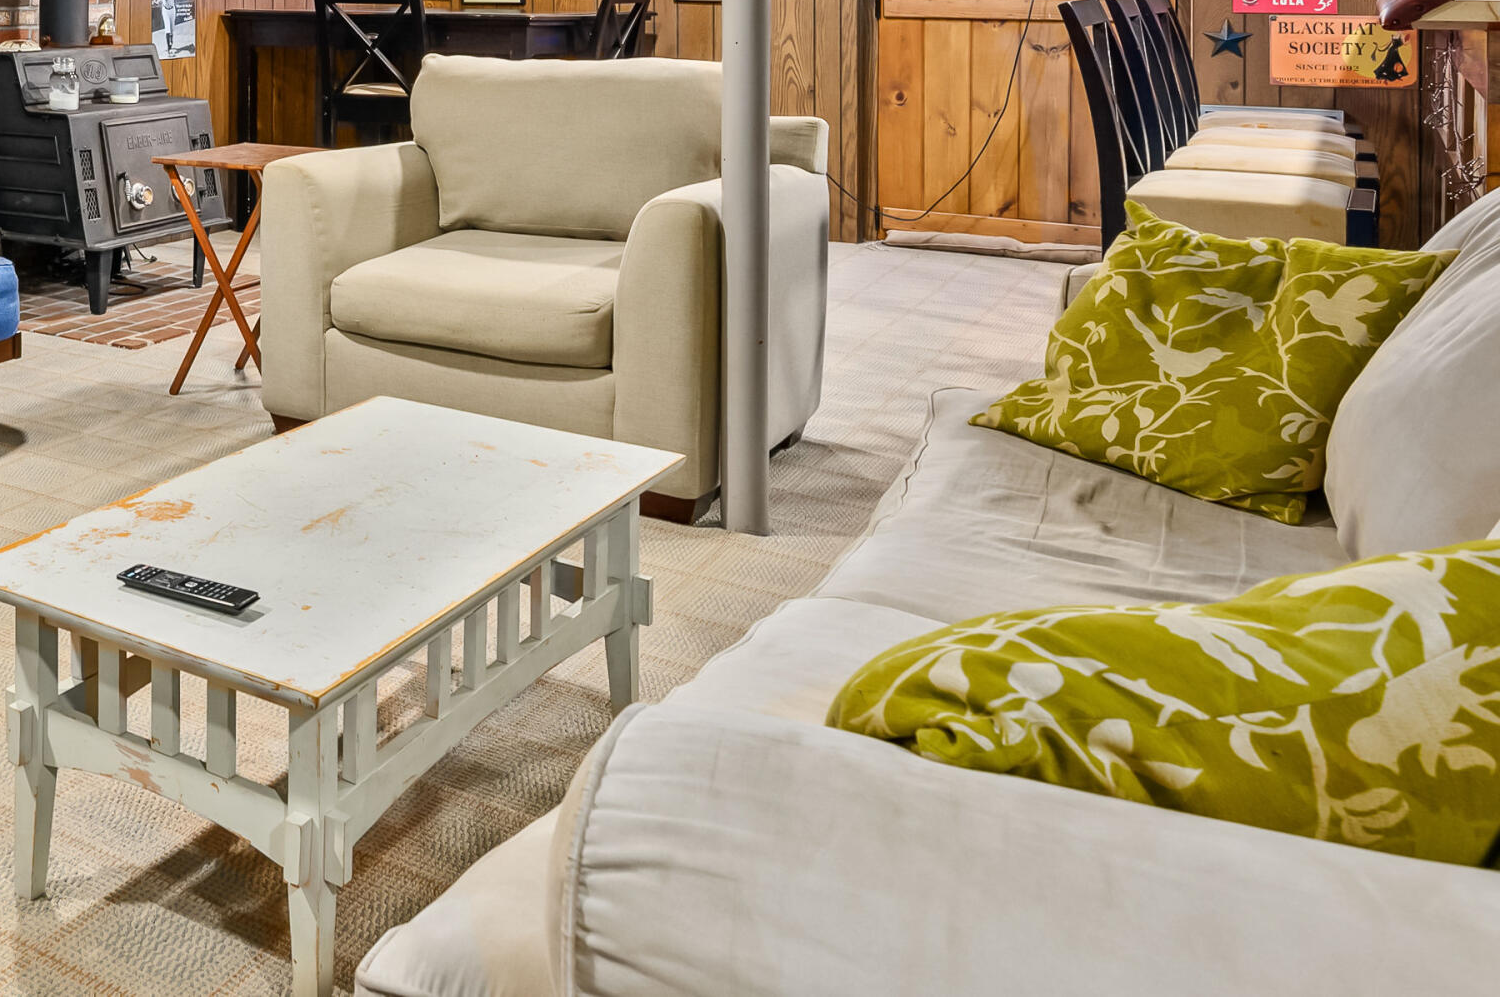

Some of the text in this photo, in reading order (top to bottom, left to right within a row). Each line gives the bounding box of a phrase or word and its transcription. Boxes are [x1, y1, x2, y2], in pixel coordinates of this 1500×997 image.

[1278, 22, 1376, 36] BLACK HAT
[1288, 42, 1366, 55] SOCIETY
